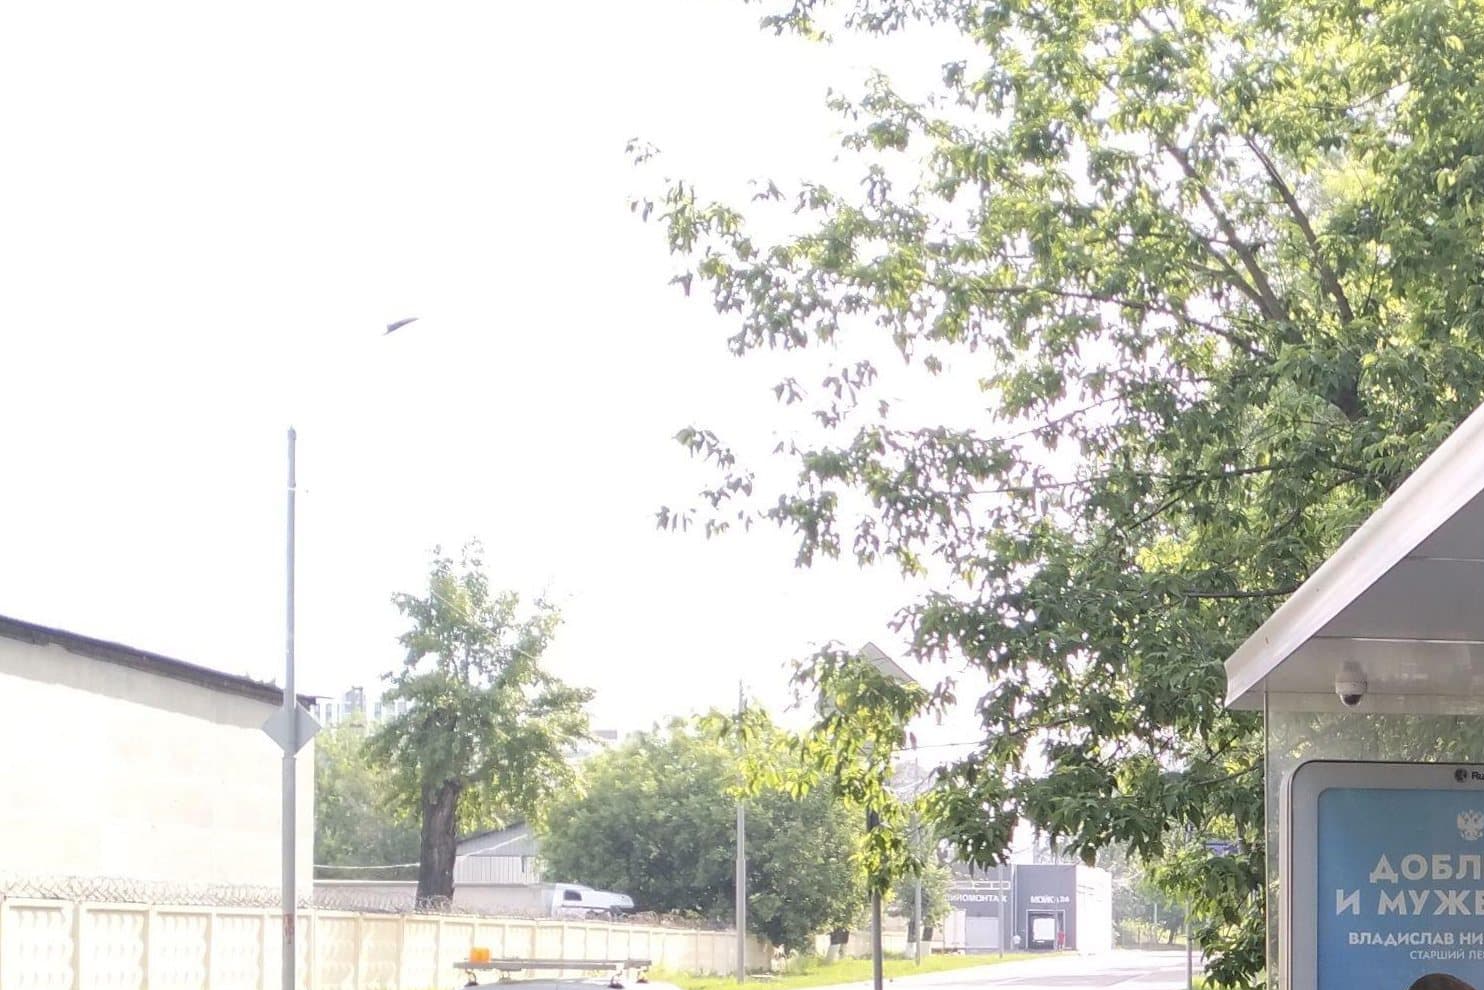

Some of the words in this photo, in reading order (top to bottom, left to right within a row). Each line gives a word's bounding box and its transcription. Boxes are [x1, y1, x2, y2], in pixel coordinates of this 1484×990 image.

[1335, 888, 1361, 916] И
[1348, 931, 1455, 947] ВЛАДИСЛАВ
[1409, 949, 1465, 961] СТАРШИЙ
